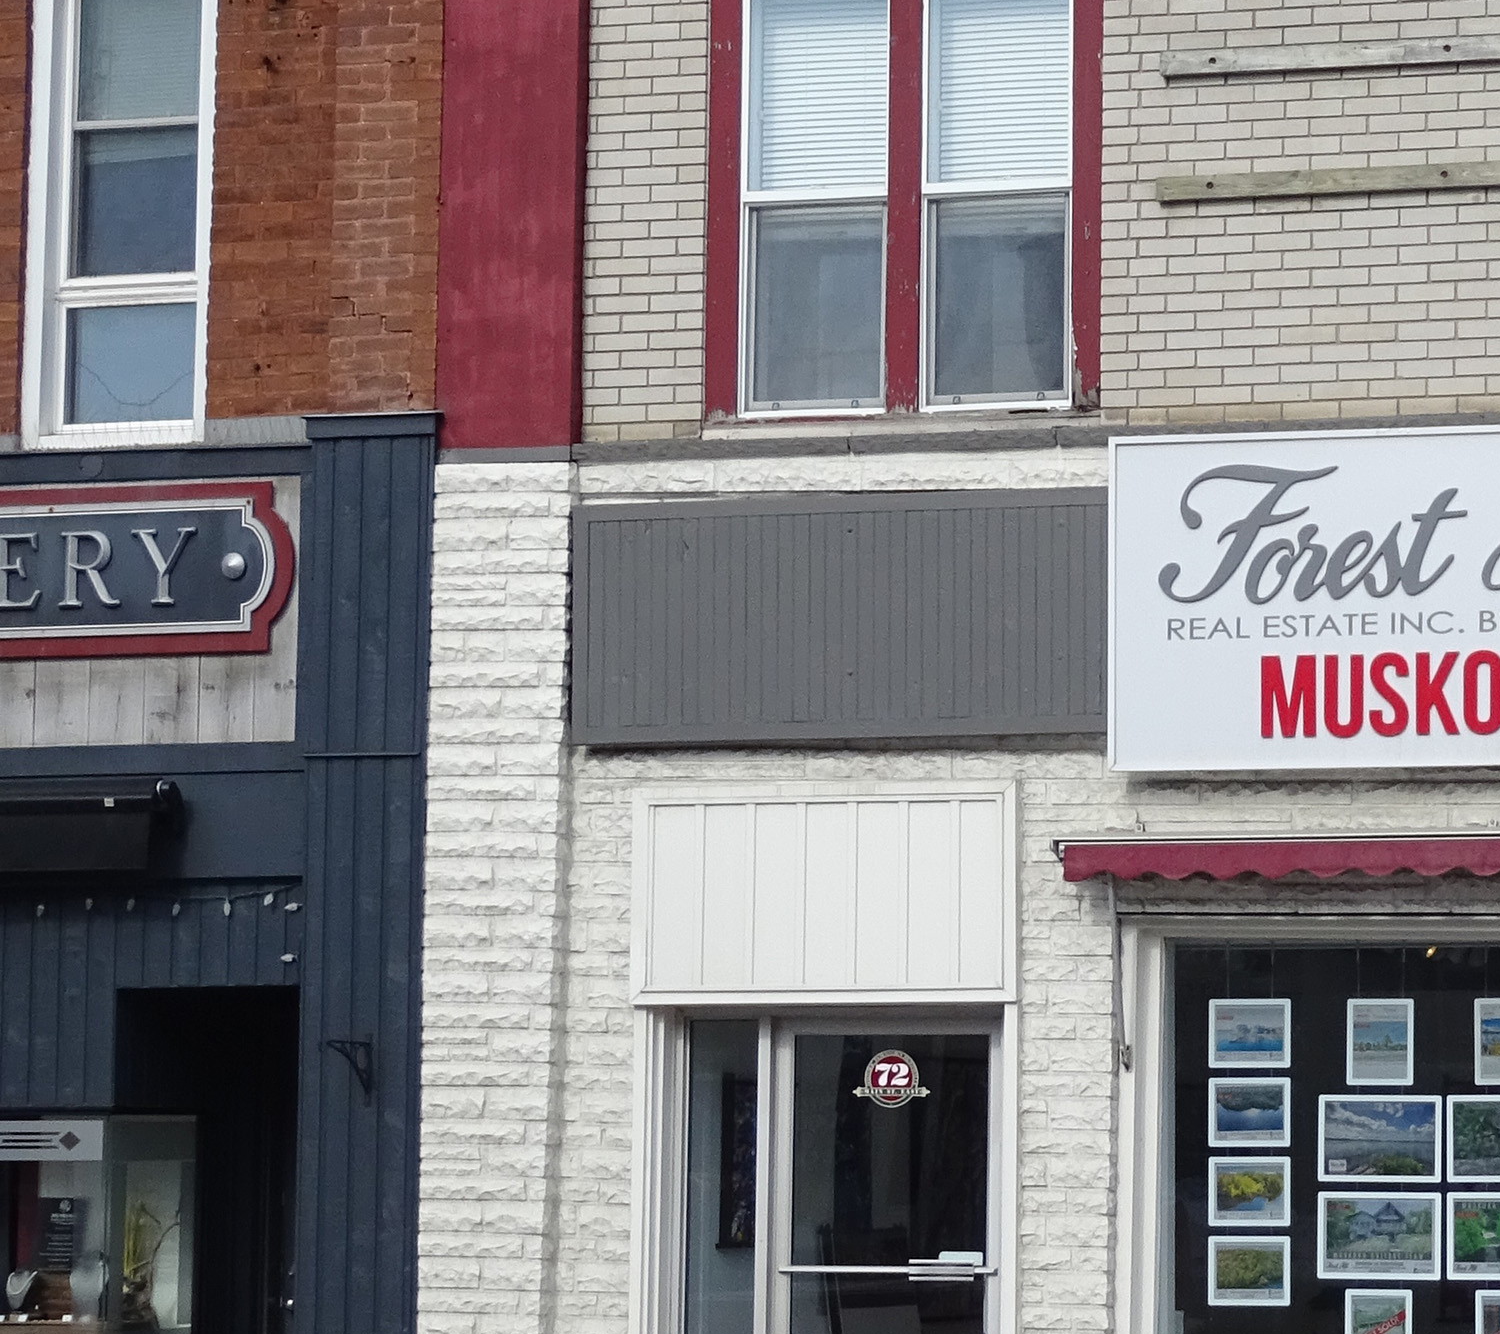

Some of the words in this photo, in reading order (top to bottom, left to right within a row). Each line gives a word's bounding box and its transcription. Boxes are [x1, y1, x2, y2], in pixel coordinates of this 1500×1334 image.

[1158, 464, 1468, 605] Forest
[1166, 617, 1250, 641] REAL
[1263, 612, 1378, 639] ESTATE
[1391, 610, 1465, 635] INC.
[874, 1062, 910, 1087] 72
[1378, 1316, 1399, 1334] SOLD!
